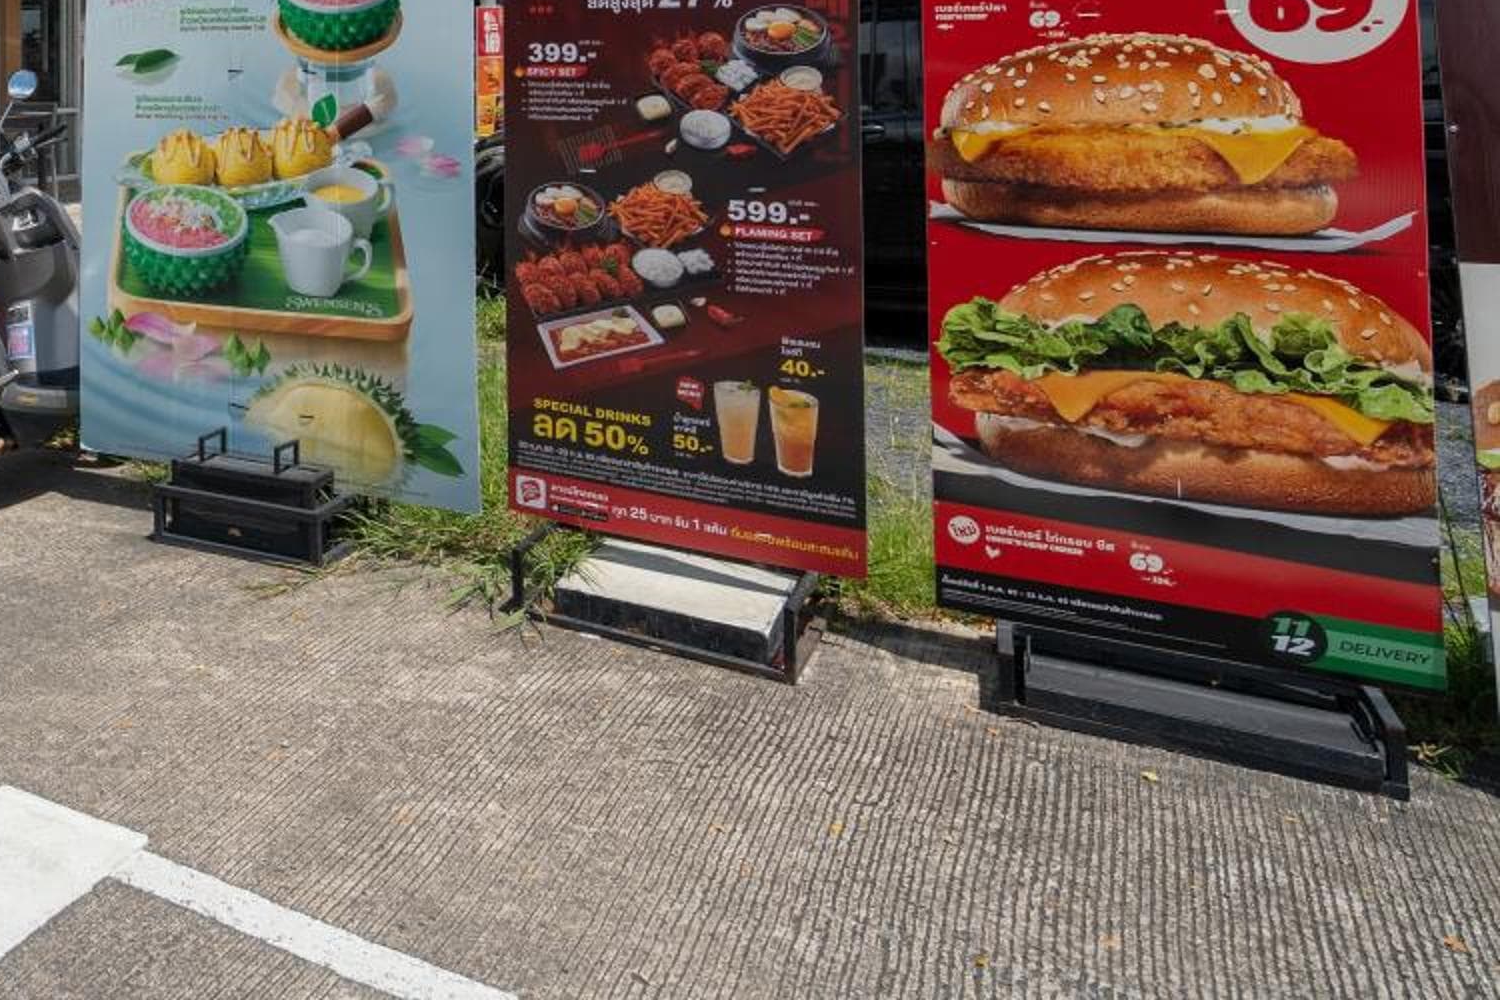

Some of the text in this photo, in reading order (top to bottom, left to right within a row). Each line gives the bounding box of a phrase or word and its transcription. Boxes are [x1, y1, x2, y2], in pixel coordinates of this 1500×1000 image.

[528, 42, 597, 63] 399.-
[727, 199, 811, 225] 599.-
[533, 397, 593, 417] SPECIAL
[595, 407, 651, 427] DRINKS
[533, 413, 578, 442] ลด
[584, 421, 650, 455] 50%
[629, 507, 648, 521] 25
[1338, 639, 1432, 667] DELIVERY
